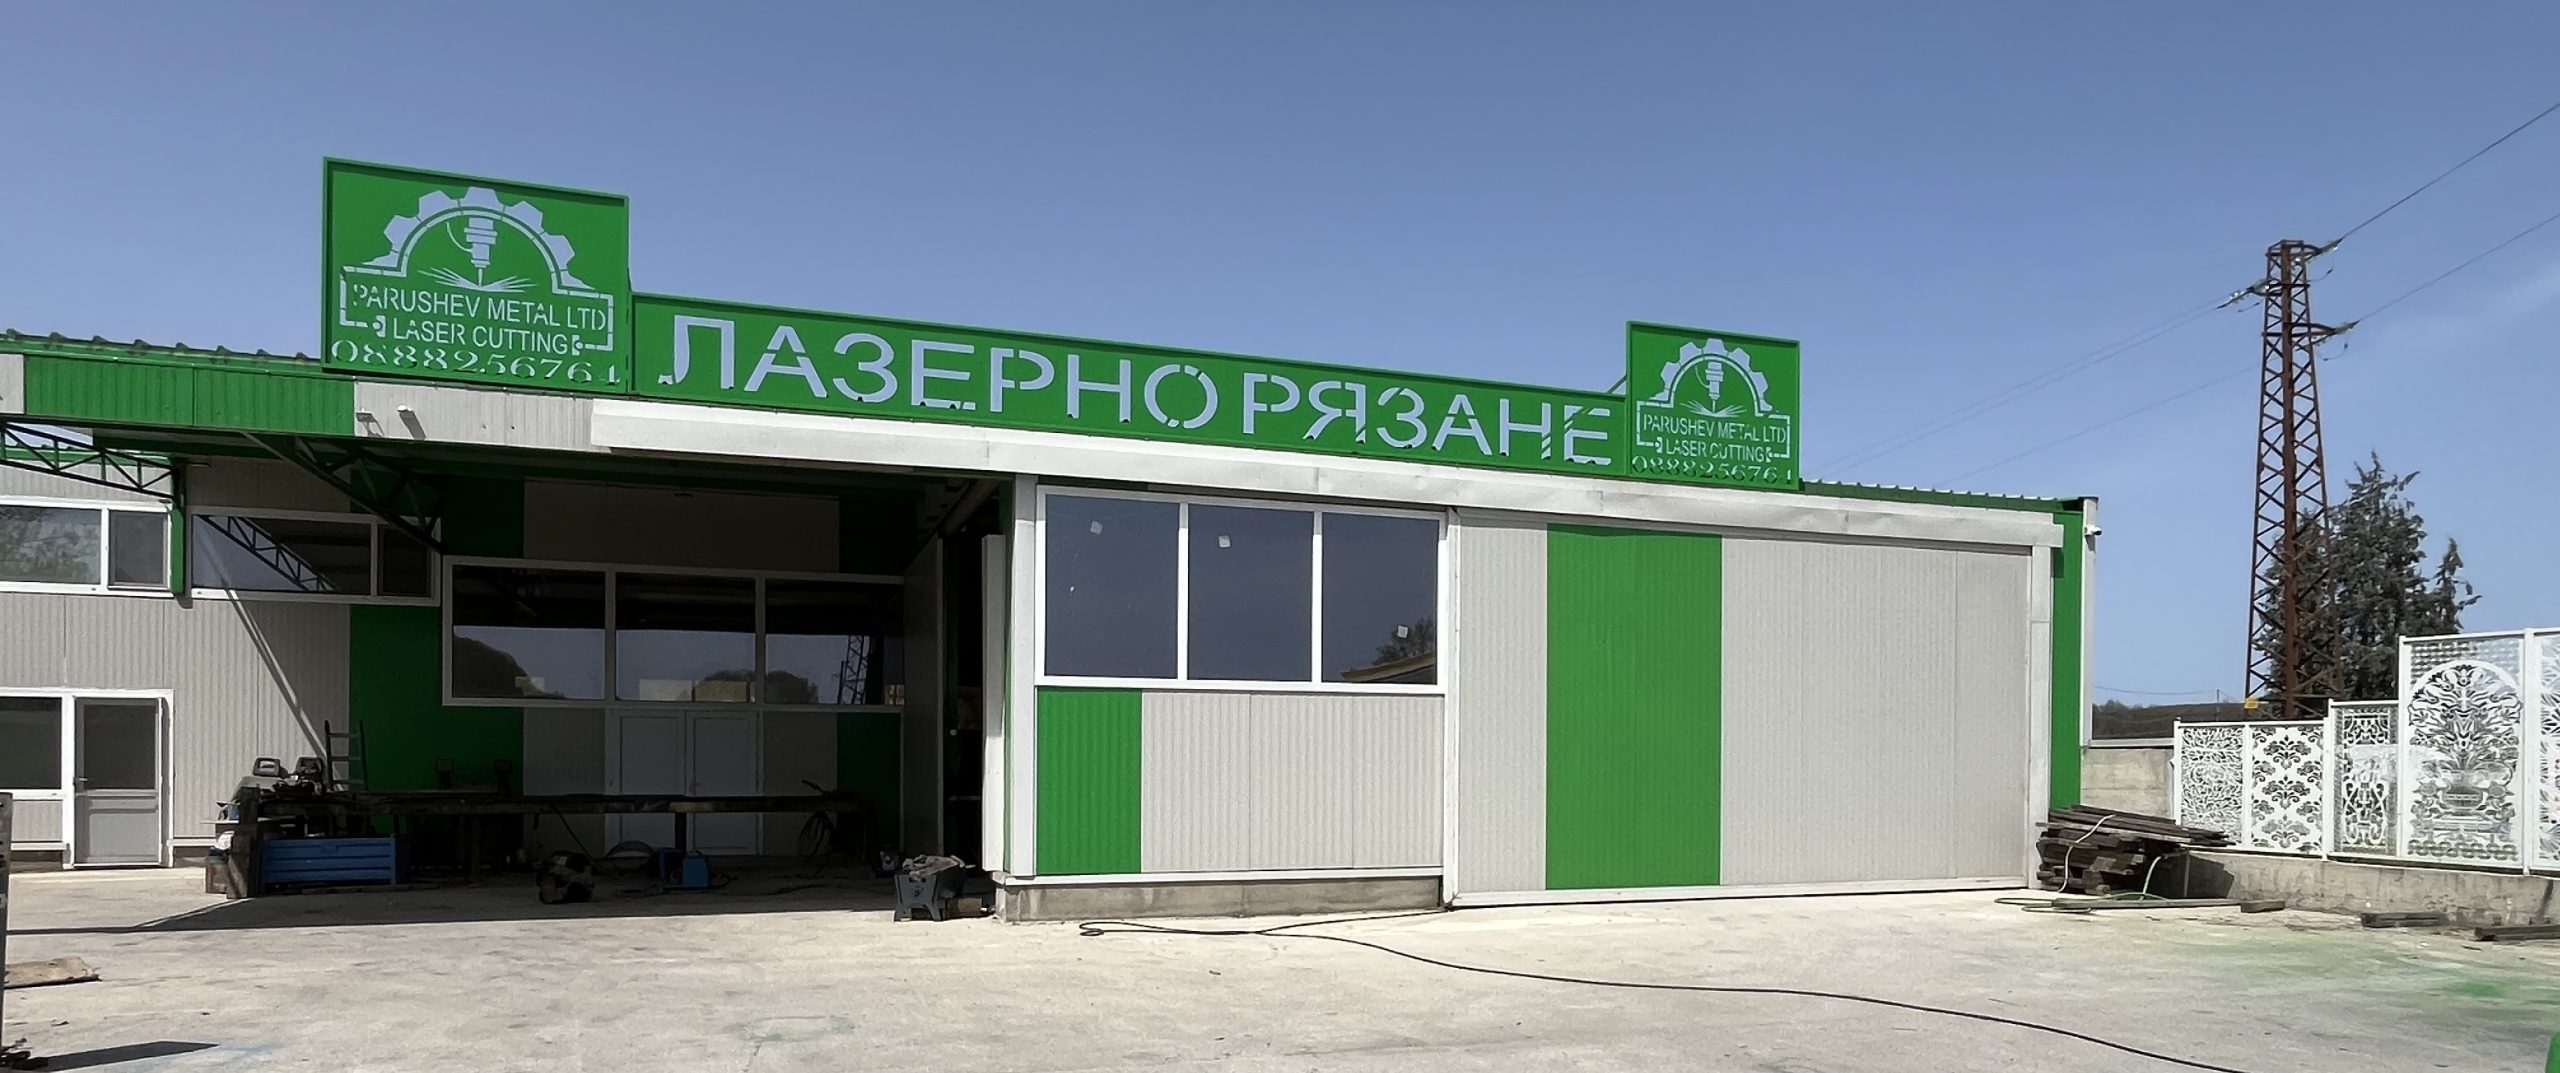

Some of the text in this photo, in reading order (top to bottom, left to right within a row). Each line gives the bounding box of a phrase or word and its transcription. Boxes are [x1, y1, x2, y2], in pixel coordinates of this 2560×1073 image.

[353, 283, 607, 331] PARUSHEV METAL LTD
[393, 317, 568, 355] LASER CUTTING
[657, 314, 1612, 466] ЛАЗЕРНО РЯЗАНЕ
[1643, 414, 1787, 444] PARUSHEV METAL LTD
[1666, 438, 1764, 462] LASER CUTTING
